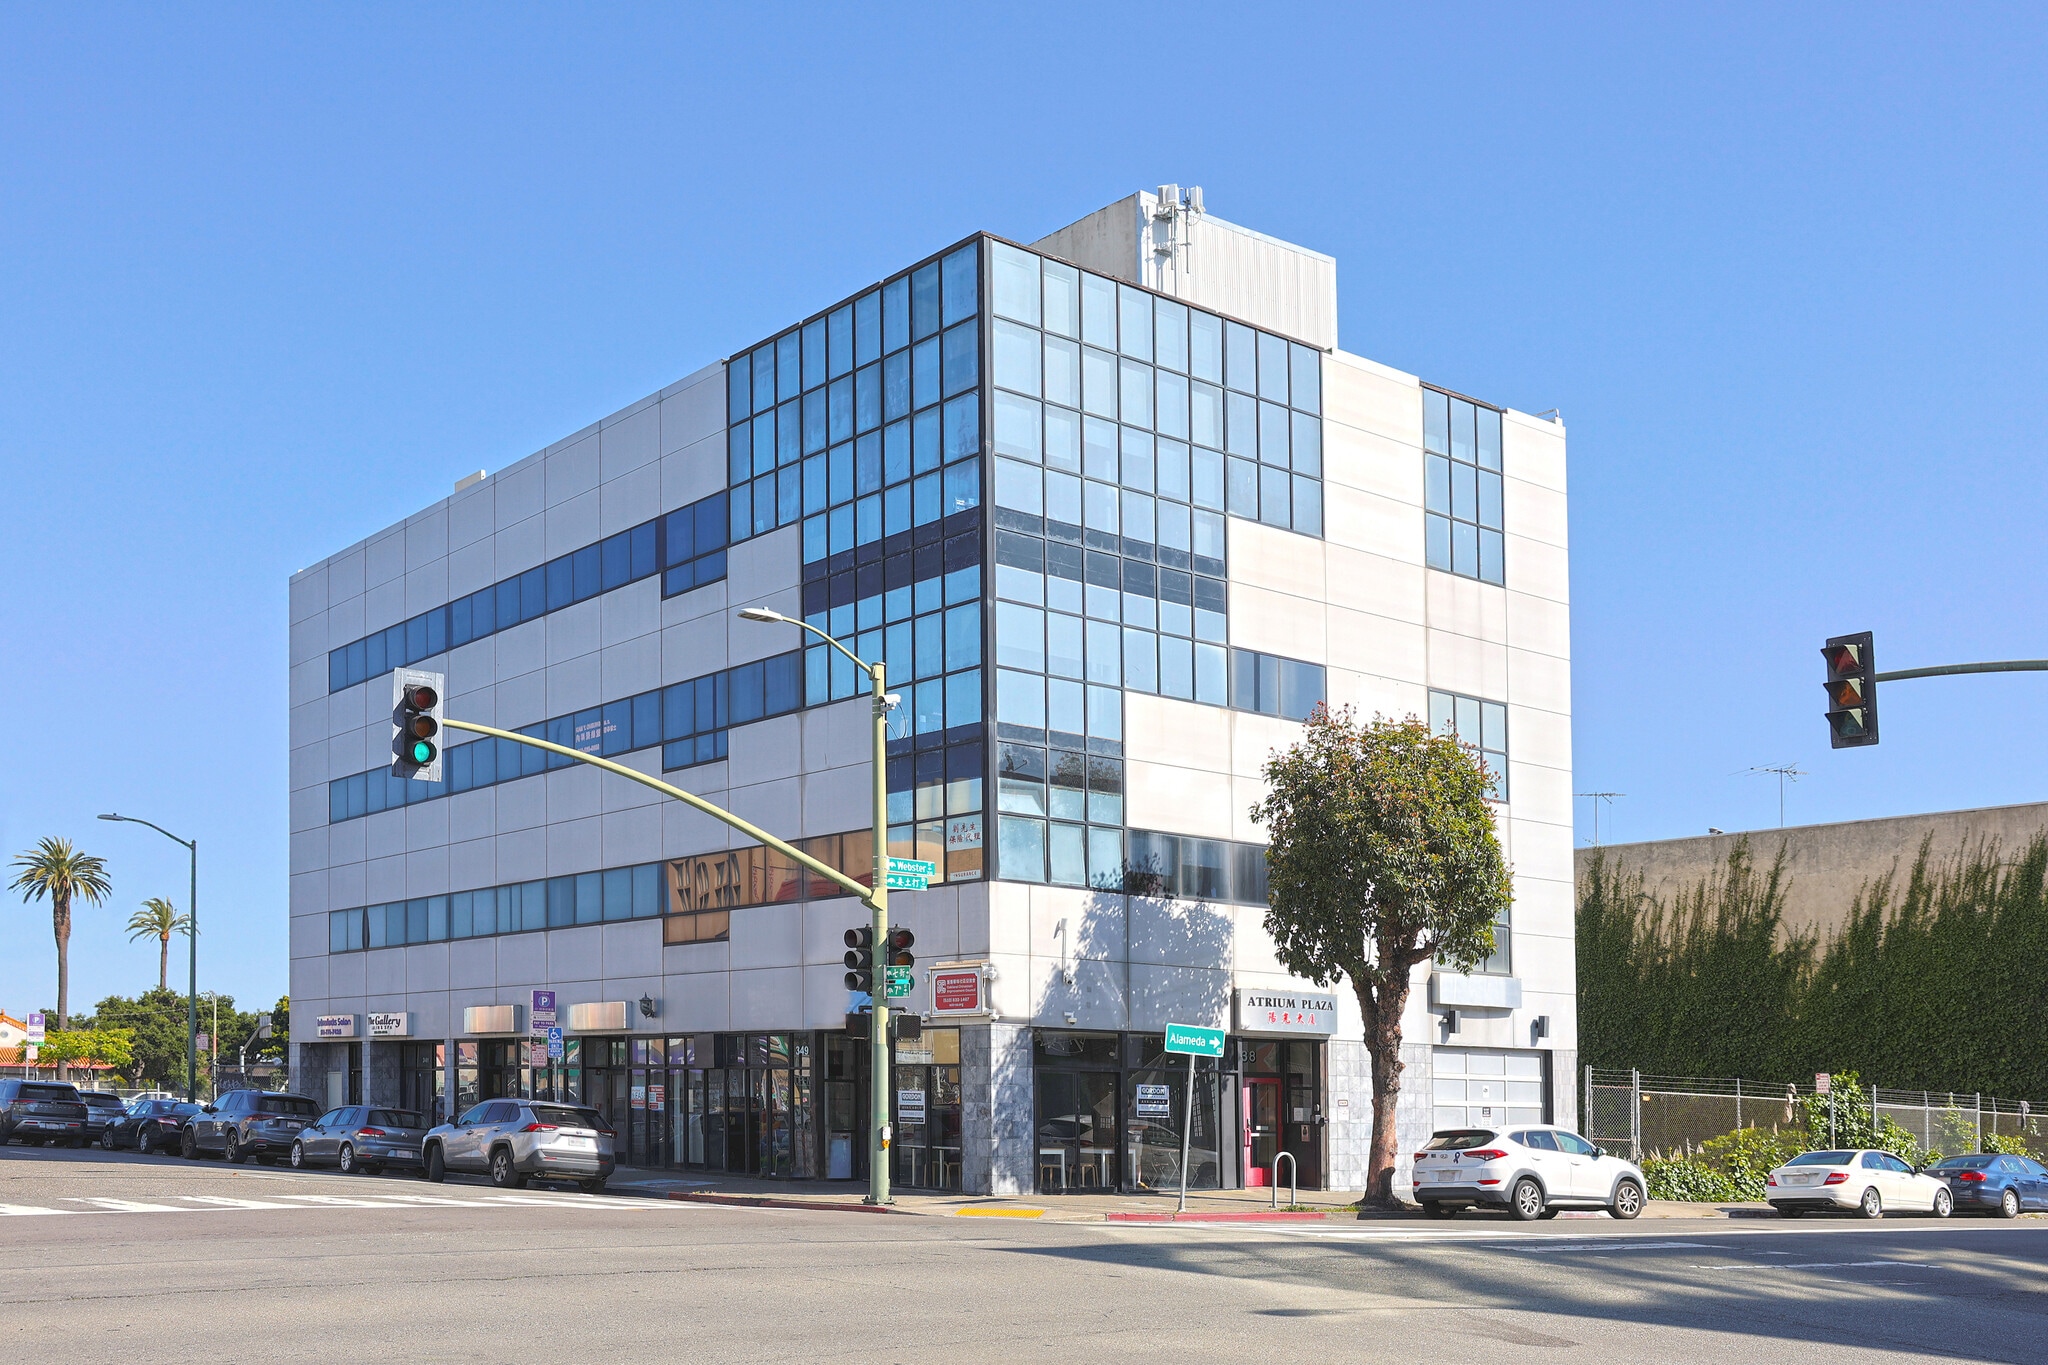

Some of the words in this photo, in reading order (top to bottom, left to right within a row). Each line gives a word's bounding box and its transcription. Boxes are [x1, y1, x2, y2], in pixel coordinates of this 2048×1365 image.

[896, 861, 927, 873] Webster
[953, 870, 977, 878] INSURANCE
[1247, 996, 1296, 1009] ATRIUM
[1301, 999, 1334, 1011] PLAZA
[337, 1017, 352, 1026] Salon
[375, 1014, 401, 1028] Gallery
[1169, 1032, 1206, 1047] Alameda
[795, 1046, 809, 1056] 349
[1141, 1087, 1166, 1095] GORDON
